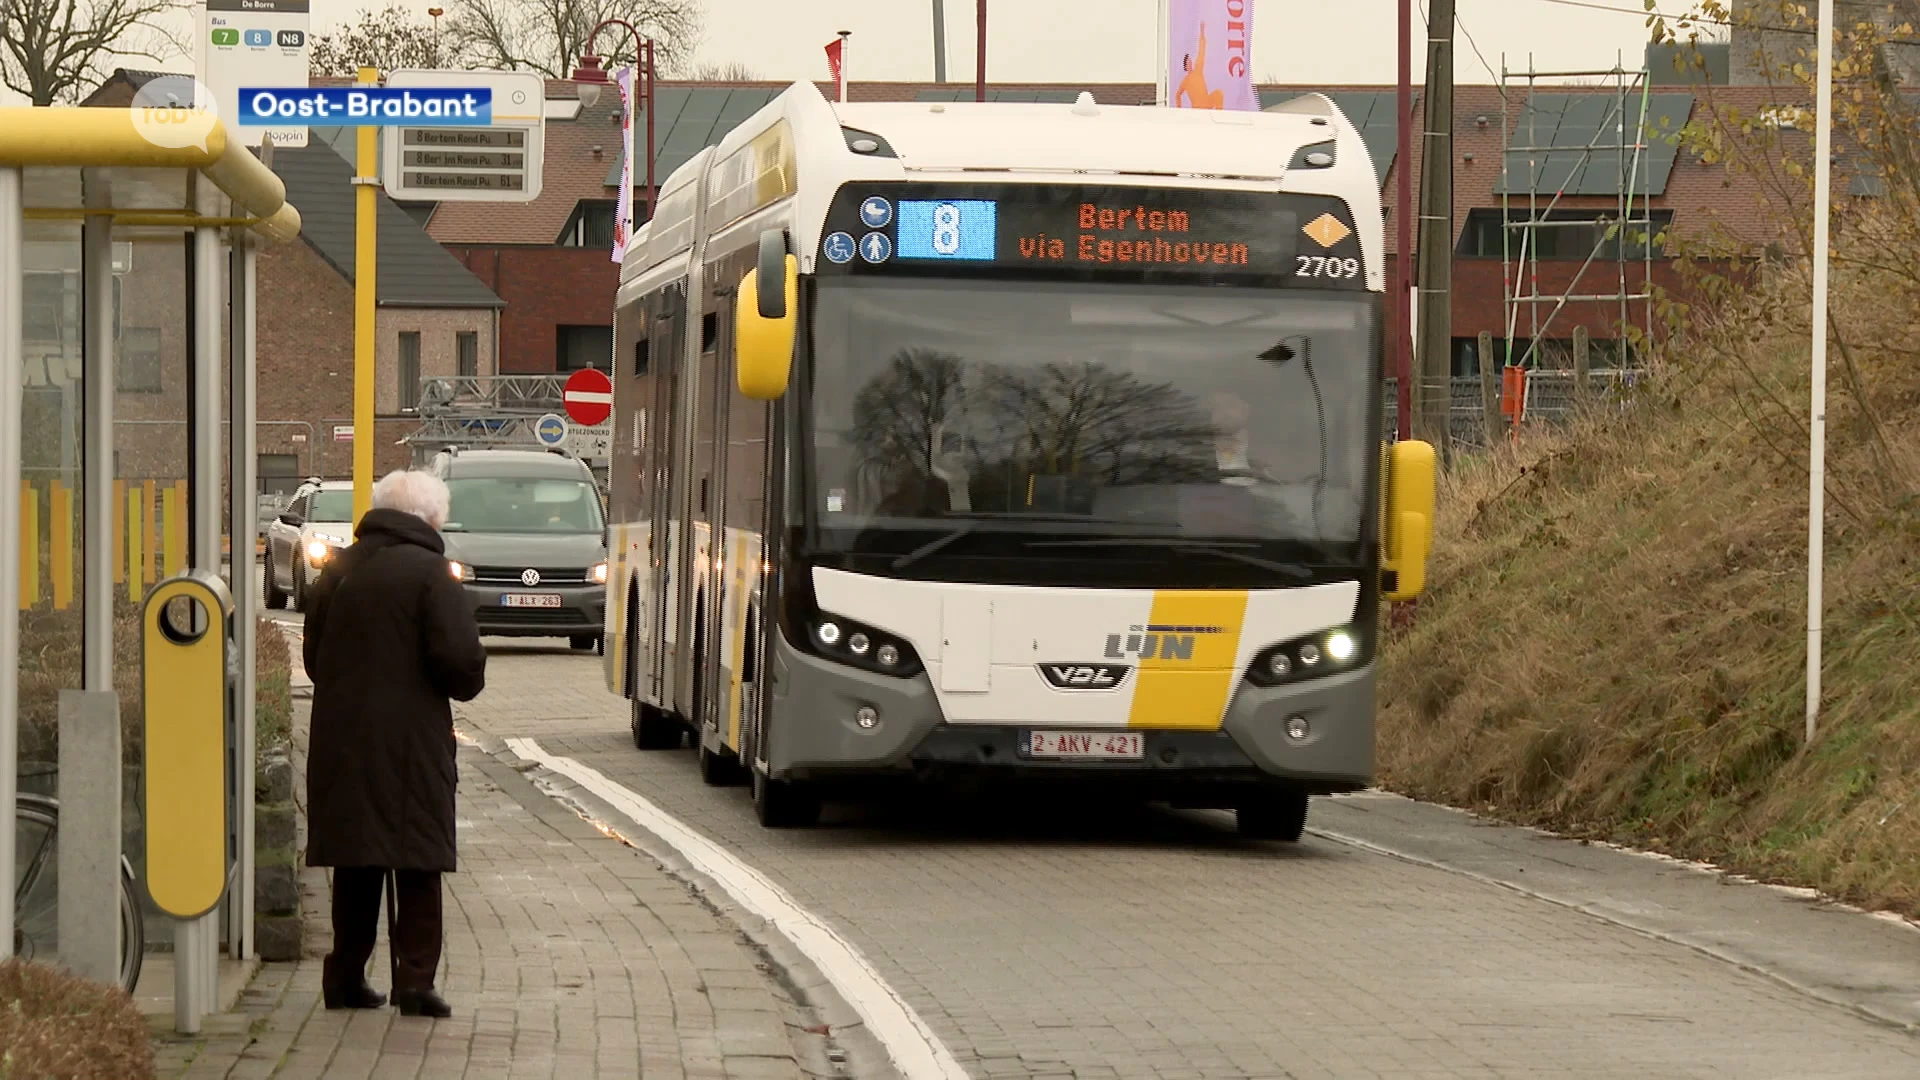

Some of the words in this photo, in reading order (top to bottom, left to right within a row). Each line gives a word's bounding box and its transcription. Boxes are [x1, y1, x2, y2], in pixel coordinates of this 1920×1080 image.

[241, 0, 254, 8] De
[254, 0, 275, 9] Borre
[211, 17, 227, 26] Bus
[221, 32, 229, 43] 7
[254, 33, 262, 44] 8
[282, 33, 299, 44] N8
[417, 131, 422, 142] 8
[425, 133, 456, 143] Bertem
[507, 133, 511, 144] 1
[417, 152, 422, 164] 8
[501, 154, 511, 165] 31
[416, 173, 422, 185] 8
[500, 176, 511, 187] 61
[1078, 204, 1189, 232] Bertem
[935, 204, 960, 255] 8
[1019, 235, 1065, 260] via
[1077, 237, 1248, 265] Egenhoven
[1295, 256, 1359, 279] 2709
[1051, 666, 1115, 684] VDL
[1033, 734, 1138, 754] 2-AKV-421
